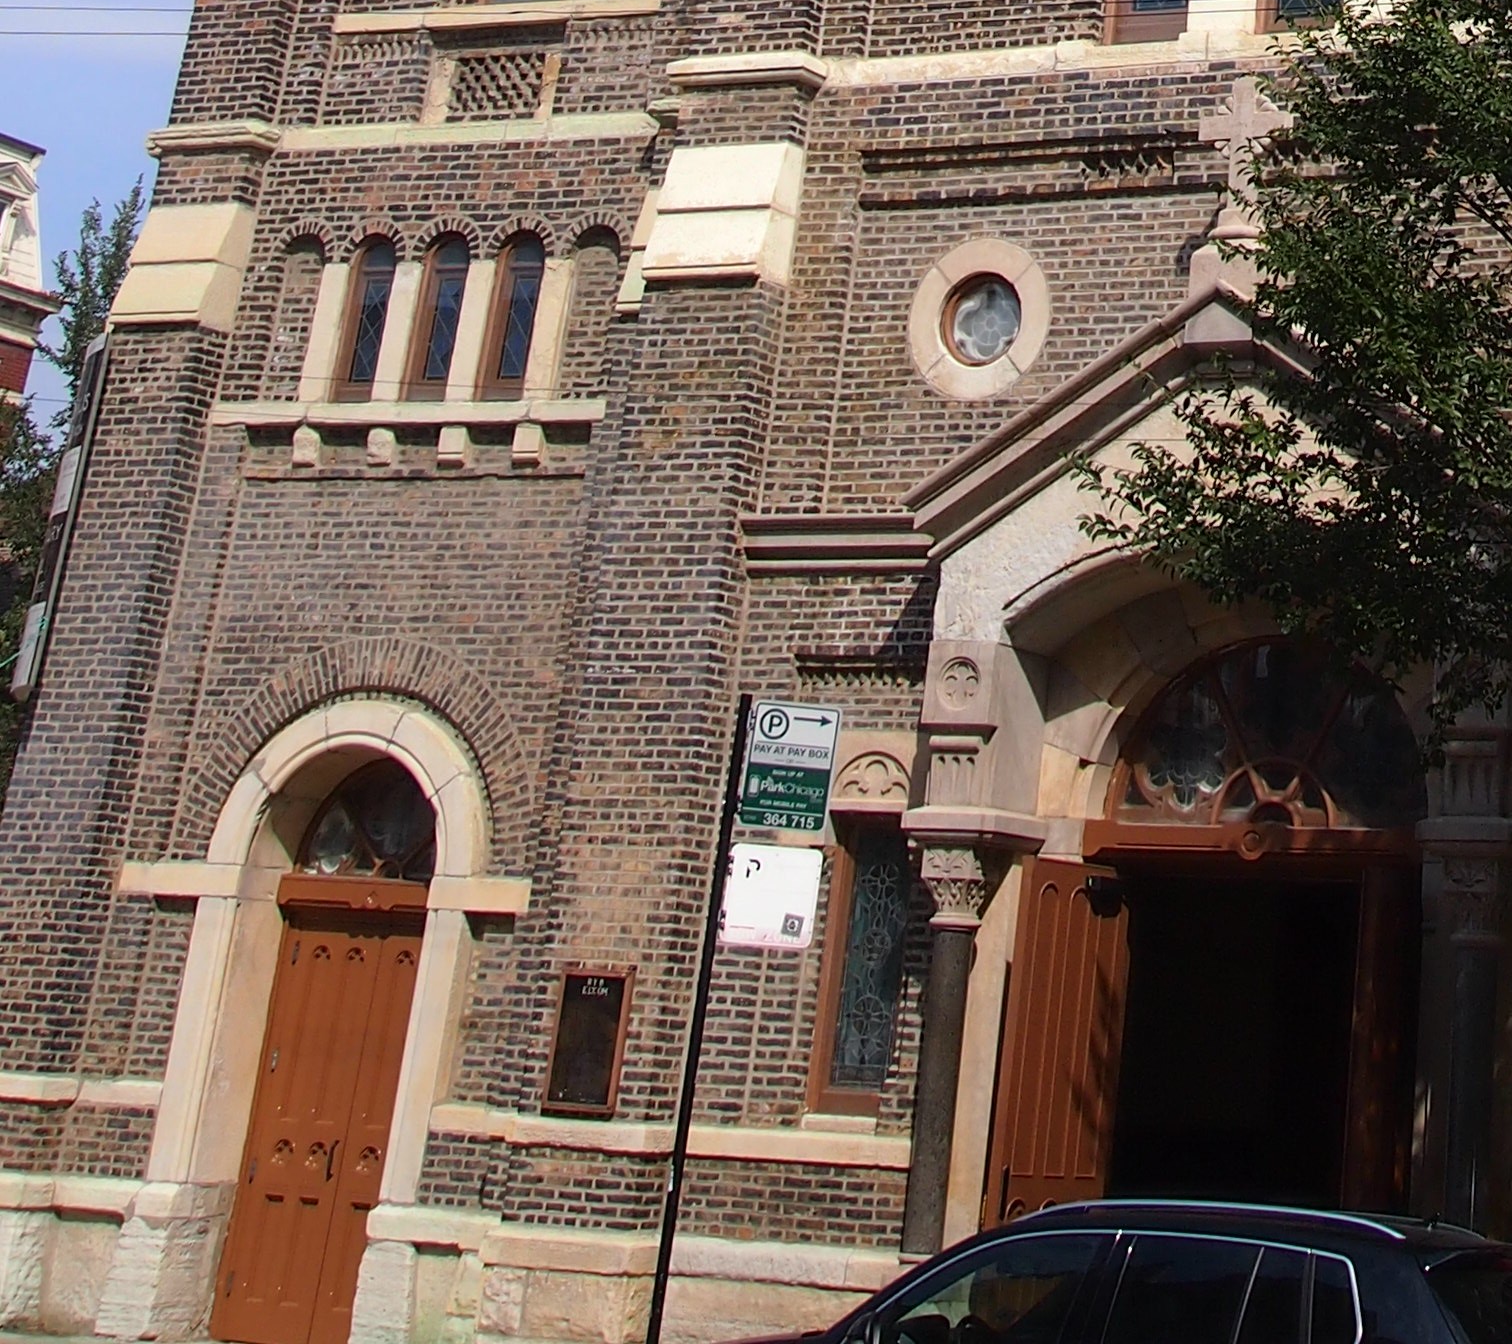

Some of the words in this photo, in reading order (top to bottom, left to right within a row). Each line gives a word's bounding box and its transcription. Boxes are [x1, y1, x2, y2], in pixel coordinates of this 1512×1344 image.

[754, 744, 772, 752] PAY
[774, 746, 786, 754] AT
[788, 747, 806, 756] PAY
[808, 749, 830, 759] BOX
[763, 813, 787, 826] 364
[791, 815, 815, 829] 715
